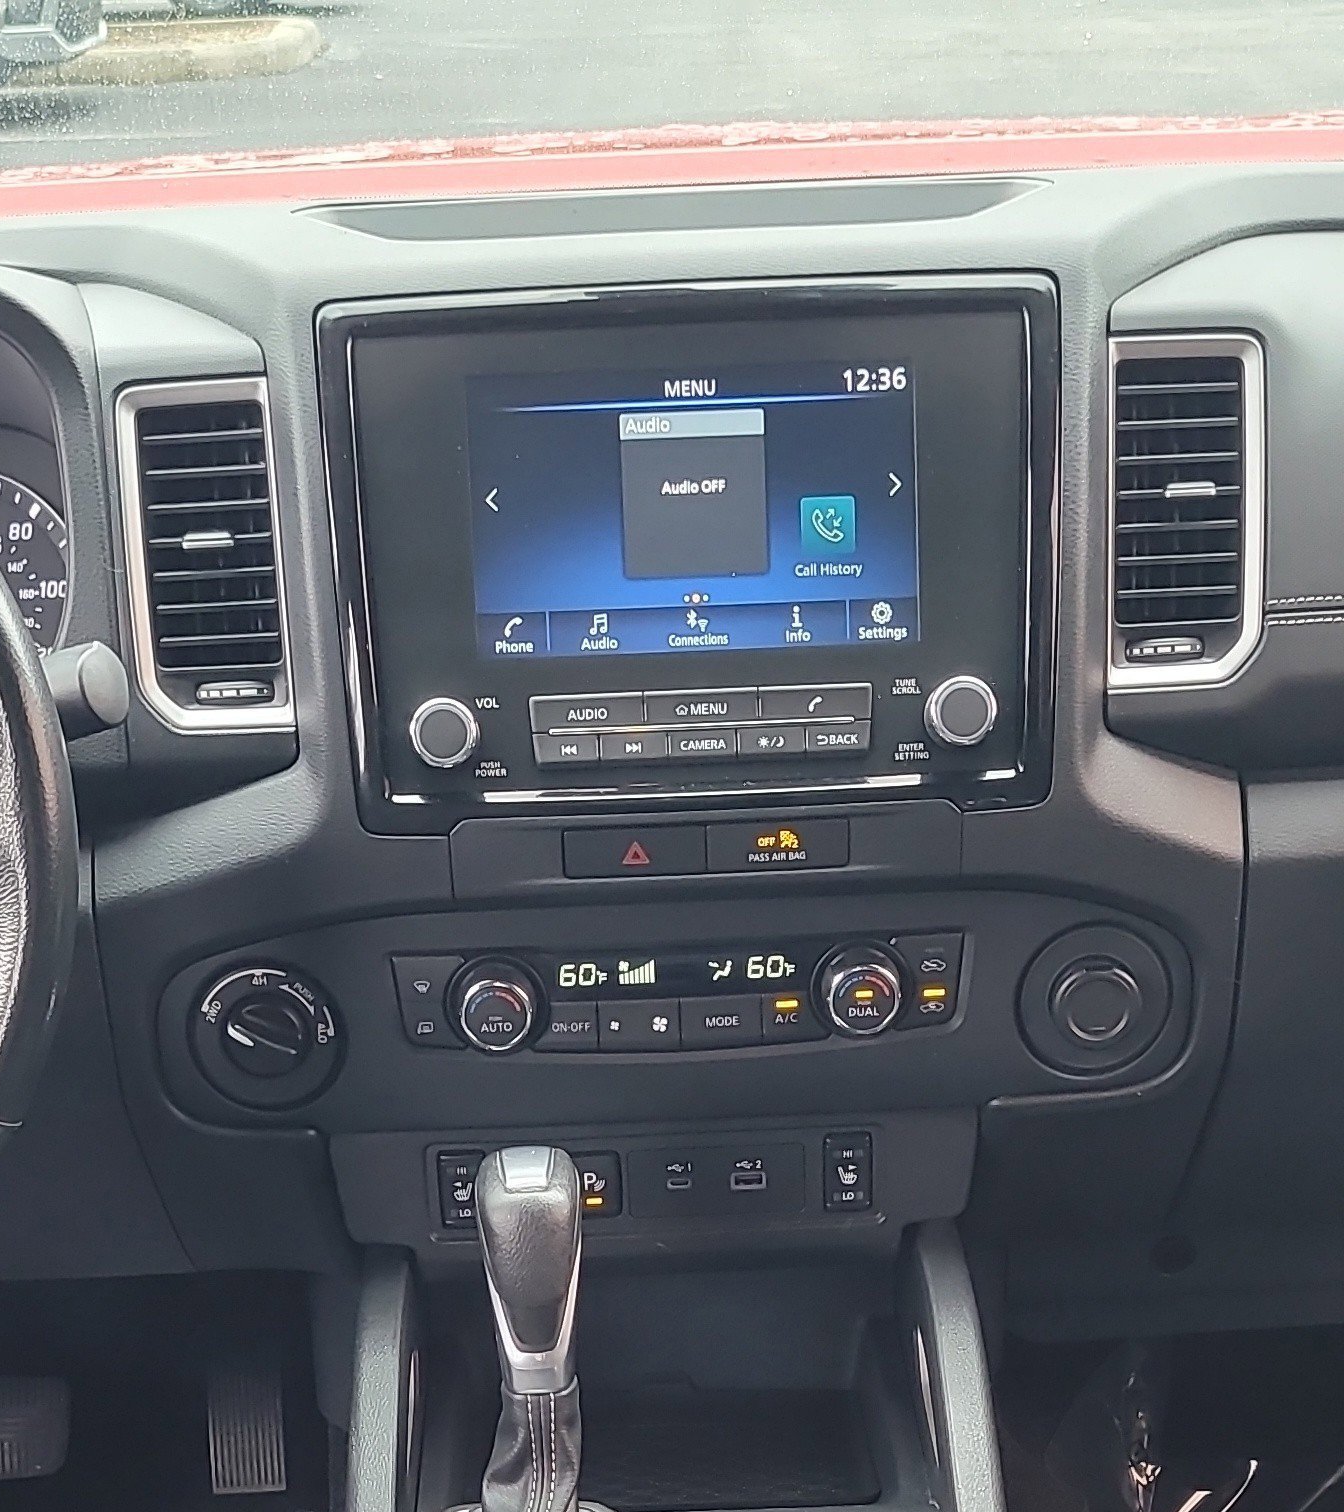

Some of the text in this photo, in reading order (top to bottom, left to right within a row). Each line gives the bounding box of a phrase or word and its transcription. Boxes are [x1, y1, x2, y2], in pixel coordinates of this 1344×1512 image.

[843, 366, 907, 392] 12:36
[664, 379, 717, 398] MENU
[625, 417, 670, 434] Audio
[661, 478, 727, 496] Audio OFF
[8, 522, 33, 541] 80
[7, 562, 24, 573] 140
[794, 560, 863, 578] Call History
[39, 580, 67, 598] 100
[785, 626, 811, 643] Info
[859, 625, 908, 641] Settings
[495, 638, 534, 653] Phone
[580, 636, 619, 651] Audio
[668, 632, 729, 647] Connections
[895, 679, 917, 687] TUNE
[892, 686, 921, 695] SCROLL
[475, 697, 500, 709] VOL
[567, 707, 608, 721] AUDIO
[690, 703, 728, 716] MENU
[680, 738, 727, 751] CAMERA
[829, 733, 859, 746] BACK
[898, 742, 924, 752] ENTER
[894, 751, 930, 761] SETTING
[480, 761, 501, 769] PUSH
[475, 768, 507, 777] POWER
[757, 836, 776, 847] OFF
[748, 850, 806, 862] PASS AIR BAG
[252, 975, 268, 987] 4H
[205, 1000, 222, 1024] 2WD
[848, 1007, 880, 1018] DUAL
[706, 1015, 741, 1027] MODE
[775, 1013, 799, 1025] A/C
[480, 1021, 513, 1033] AUTO
[842, 1150, 853, 1158] HI
[755, 1160, 762, 1169] 2
[842, 1192, 855, 1201] LO
[459, 1209, 471, 1218] LO
